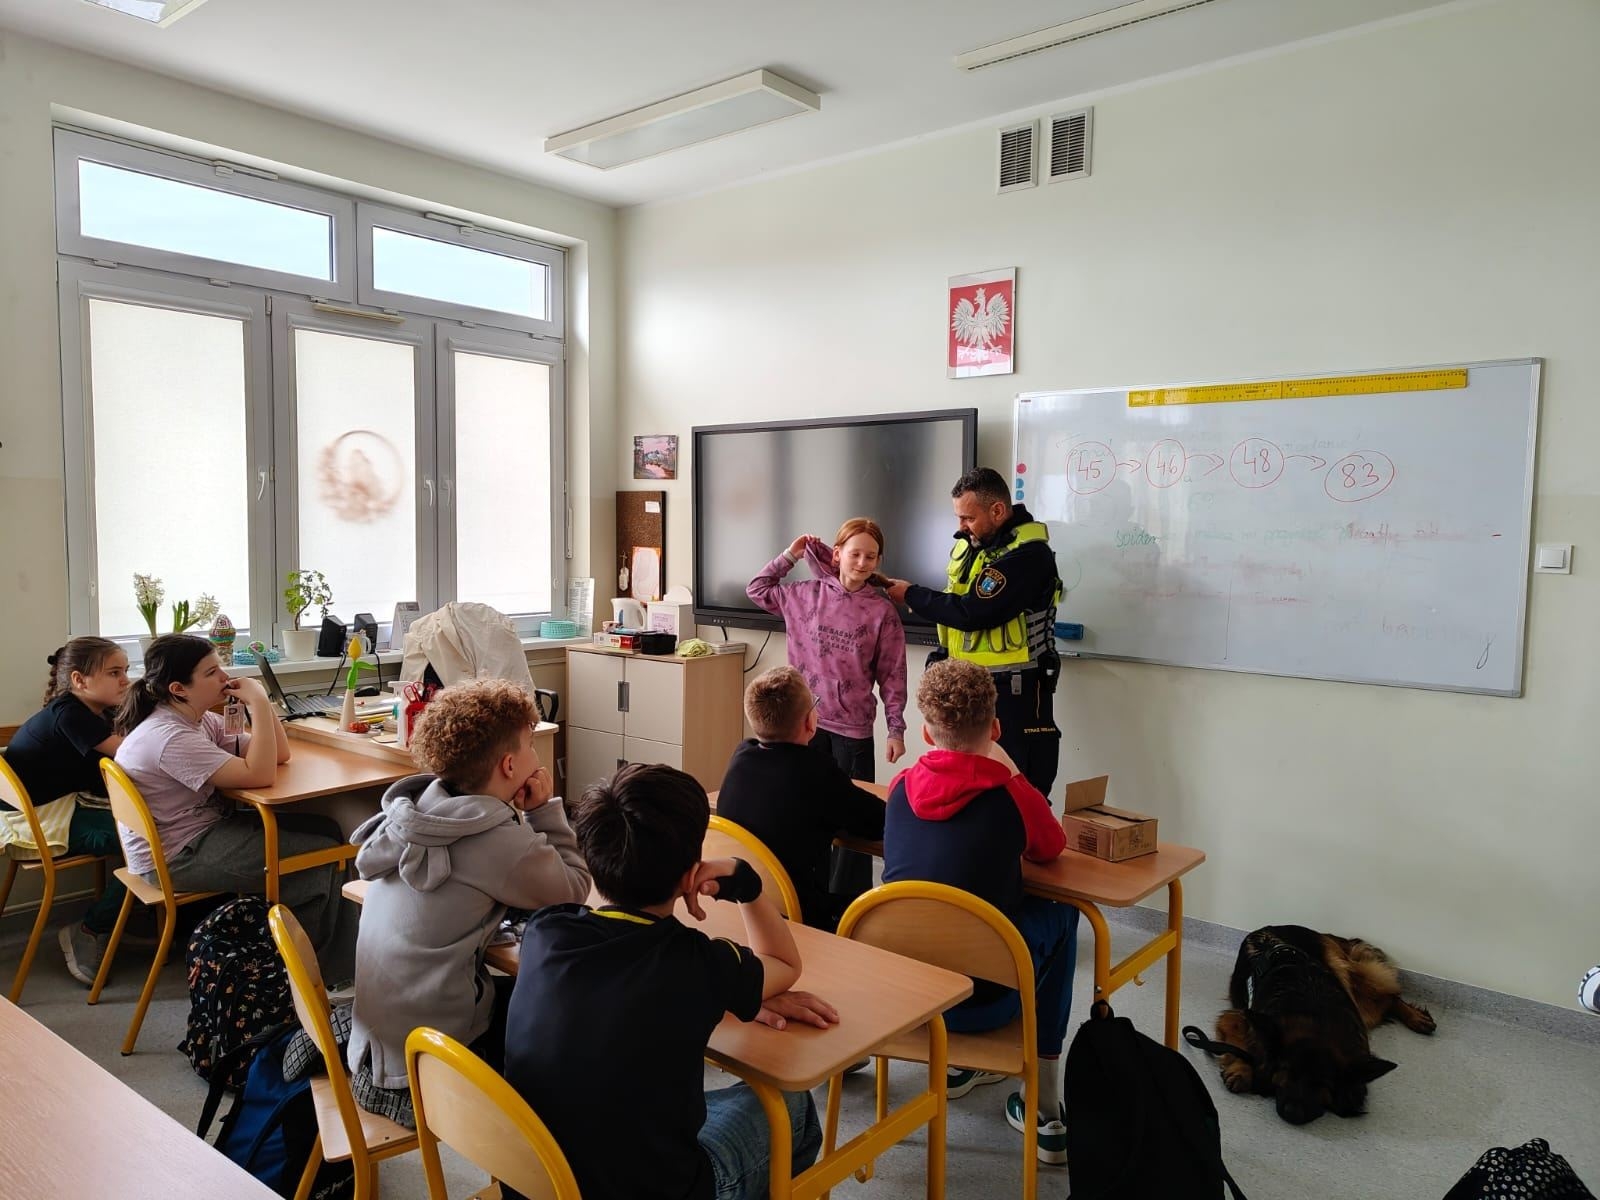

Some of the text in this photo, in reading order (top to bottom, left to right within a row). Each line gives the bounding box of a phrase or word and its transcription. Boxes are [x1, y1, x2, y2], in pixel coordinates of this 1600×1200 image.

[1077, 444, 1380, 488] 45 46 48 83
